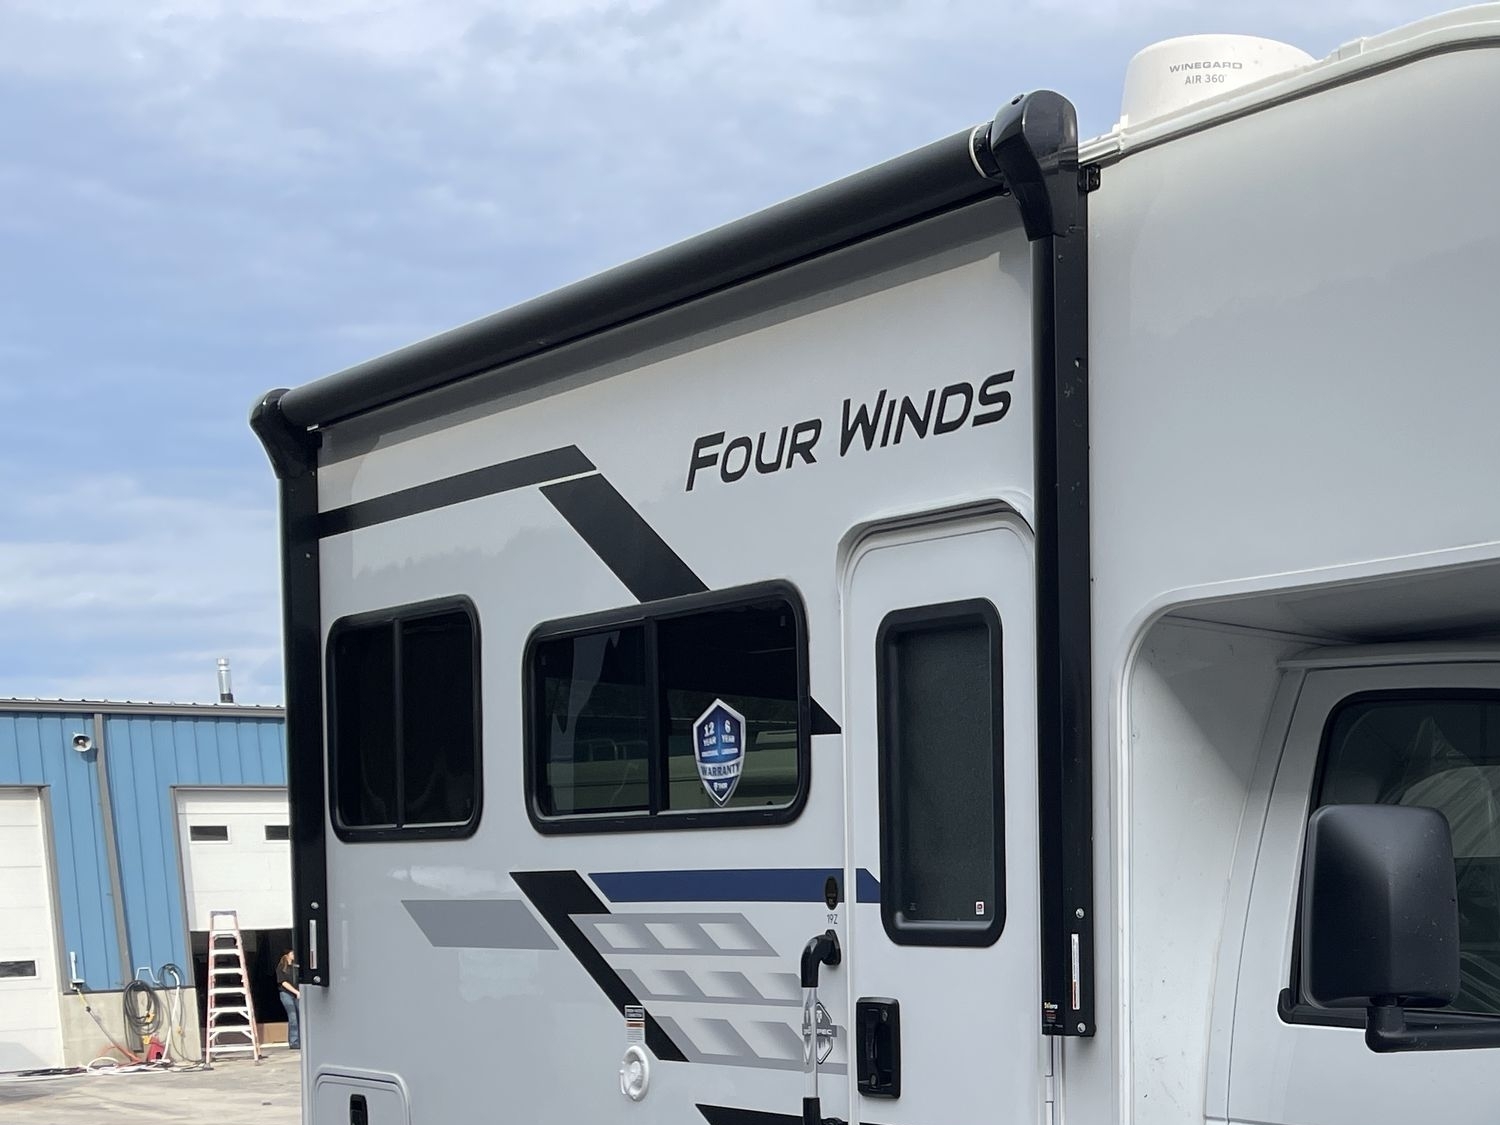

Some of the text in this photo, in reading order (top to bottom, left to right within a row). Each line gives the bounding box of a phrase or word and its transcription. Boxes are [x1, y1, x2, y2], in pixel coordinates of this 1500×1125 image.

[1169, 61, 1243, 73] WINEGARD
[1185, 74, 1202, 85] AIR
[685, 369, 1016, 492] FOUR WINDS
[703, 721, 715, 738] 12
[724, 719, 732, 734] 6
[701, 763, 740, 776] WARRANTY
